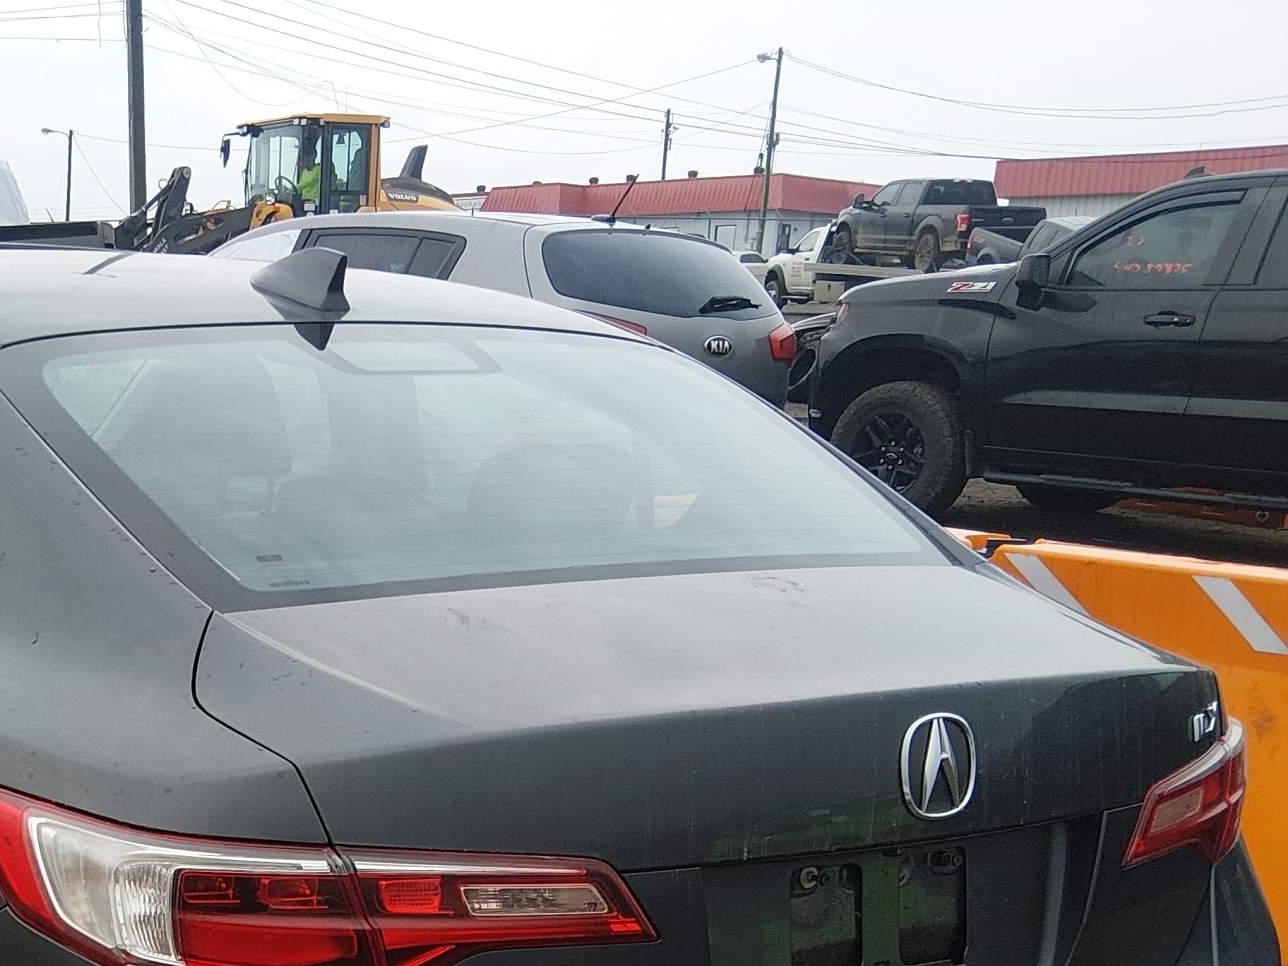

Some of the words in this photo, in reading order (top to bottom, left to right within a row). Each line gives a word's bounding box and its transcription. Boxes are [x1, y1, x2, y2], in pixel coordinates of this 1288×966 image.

[387, 192, 417, 201] VOLVO
[946, 281, 997, 293] Z71
[710, 340, 730, 353] KIA
